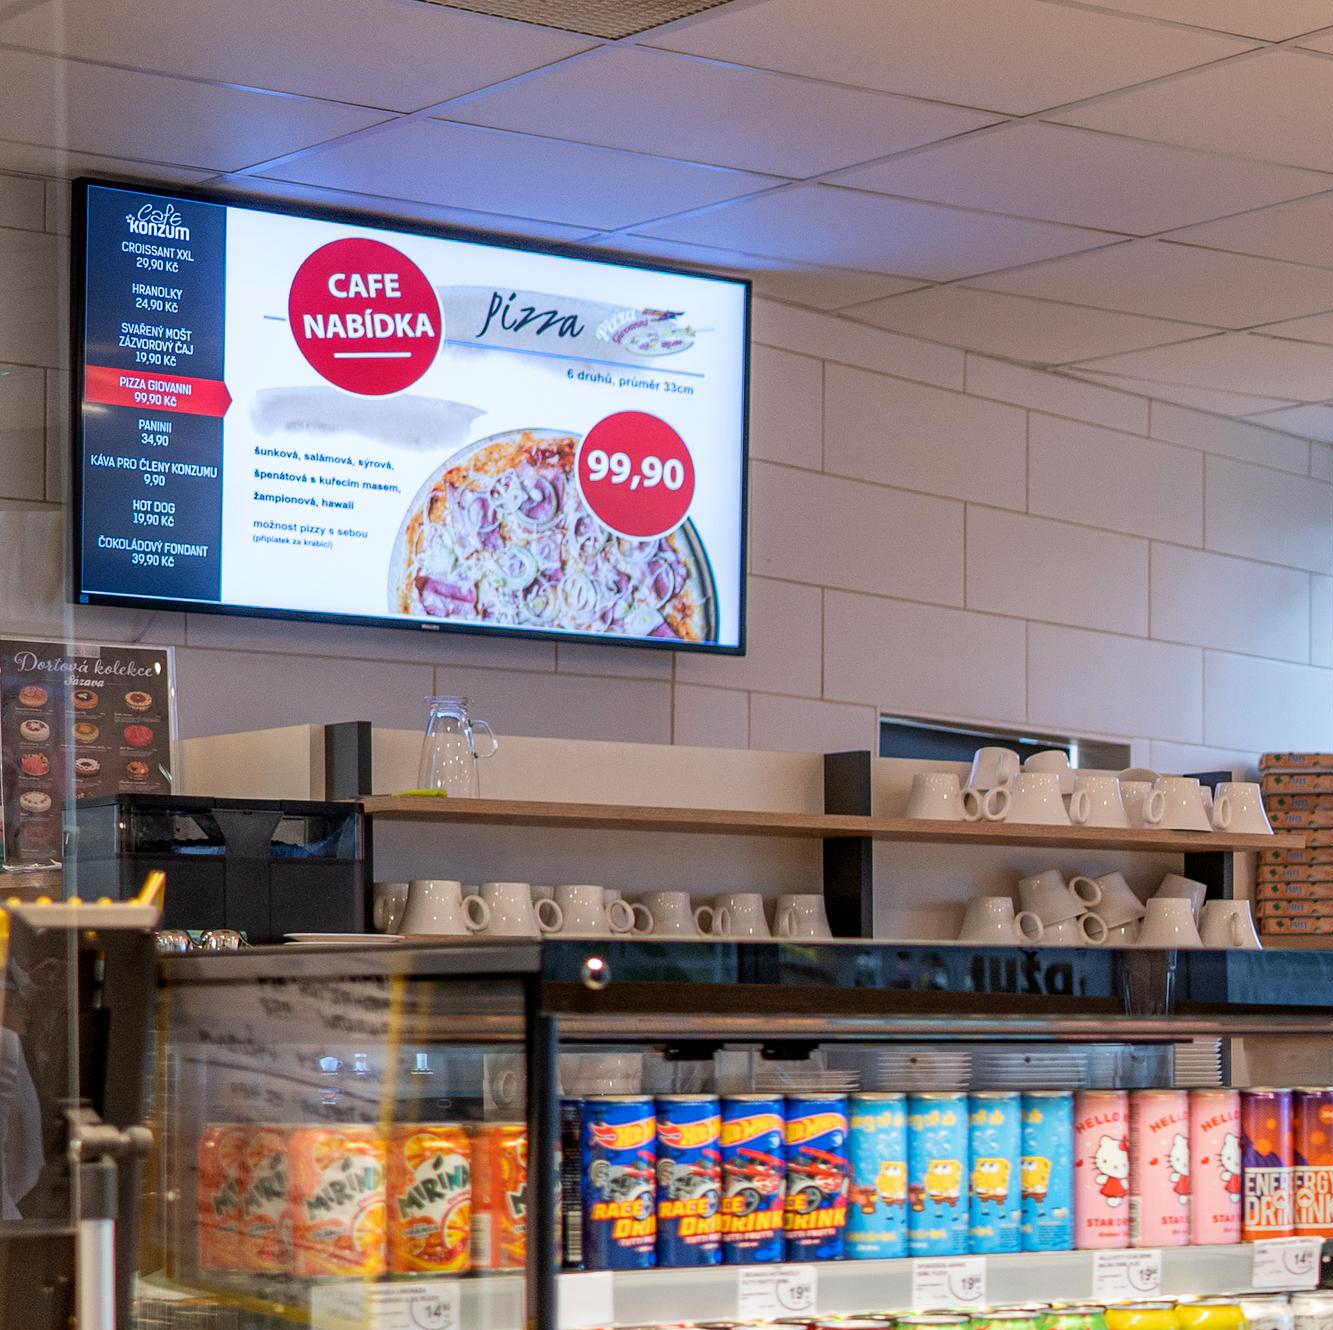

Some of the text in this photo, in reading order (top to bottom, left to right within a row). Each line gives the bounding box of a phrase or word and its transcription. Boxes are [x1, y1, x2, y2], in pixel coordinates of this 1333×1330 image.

[121, 241, 194, 262] CROISSANT XXL
[136, 257, 179, 273] 29,90 Kč
[132, 283, 183, 300] HRANOLKY
[328, 273, 401, 299] CAFE
[136, 298, 178, 313] 24,90 Kč
[121, 322, 192, 342] SVAŘENÝ MOŠT
[303, 310, 435, 339] NABÍDKA
[119, 335, 194, 356] ZÁZVOROVÝ ČAJ
[135, 352, 177, 367] 19,90 Kč
[567, 369, 574, 380] 6
[119, 376, 192, 396] PIZZA GIOVANNI
[134, 392, 177, 407] 99,90 Kč
[141, 433, 169, 447] 34,90
[90, 454, 218, 479] KÁVA PRO ČLENY KONZUMU
[587, 449, 685, 492] 99,90
[143, 474, 165, 487] 9,90
[132, 499, 176, 514] HOT DOG
[133, 512, 175, 528] 19,90 Kč
[98, 536, 209, 557] ČOKOLÁDOVÝ FONDANT
[132, 553, 175, 568] 39,90 Kč
[15, 651, 153, 678] Dortová kolekce
[1076, 1112, 1120, 1135] HELLO
[305, 1166, 384, 1221] MIRIND
[398, 1164, 470, 1218] MIRIND
[1244, 1172, 1294, 1196] ENER
[592, 1200, 642, 1220] RACE
[659, 1199, 709, 1218] RACE
